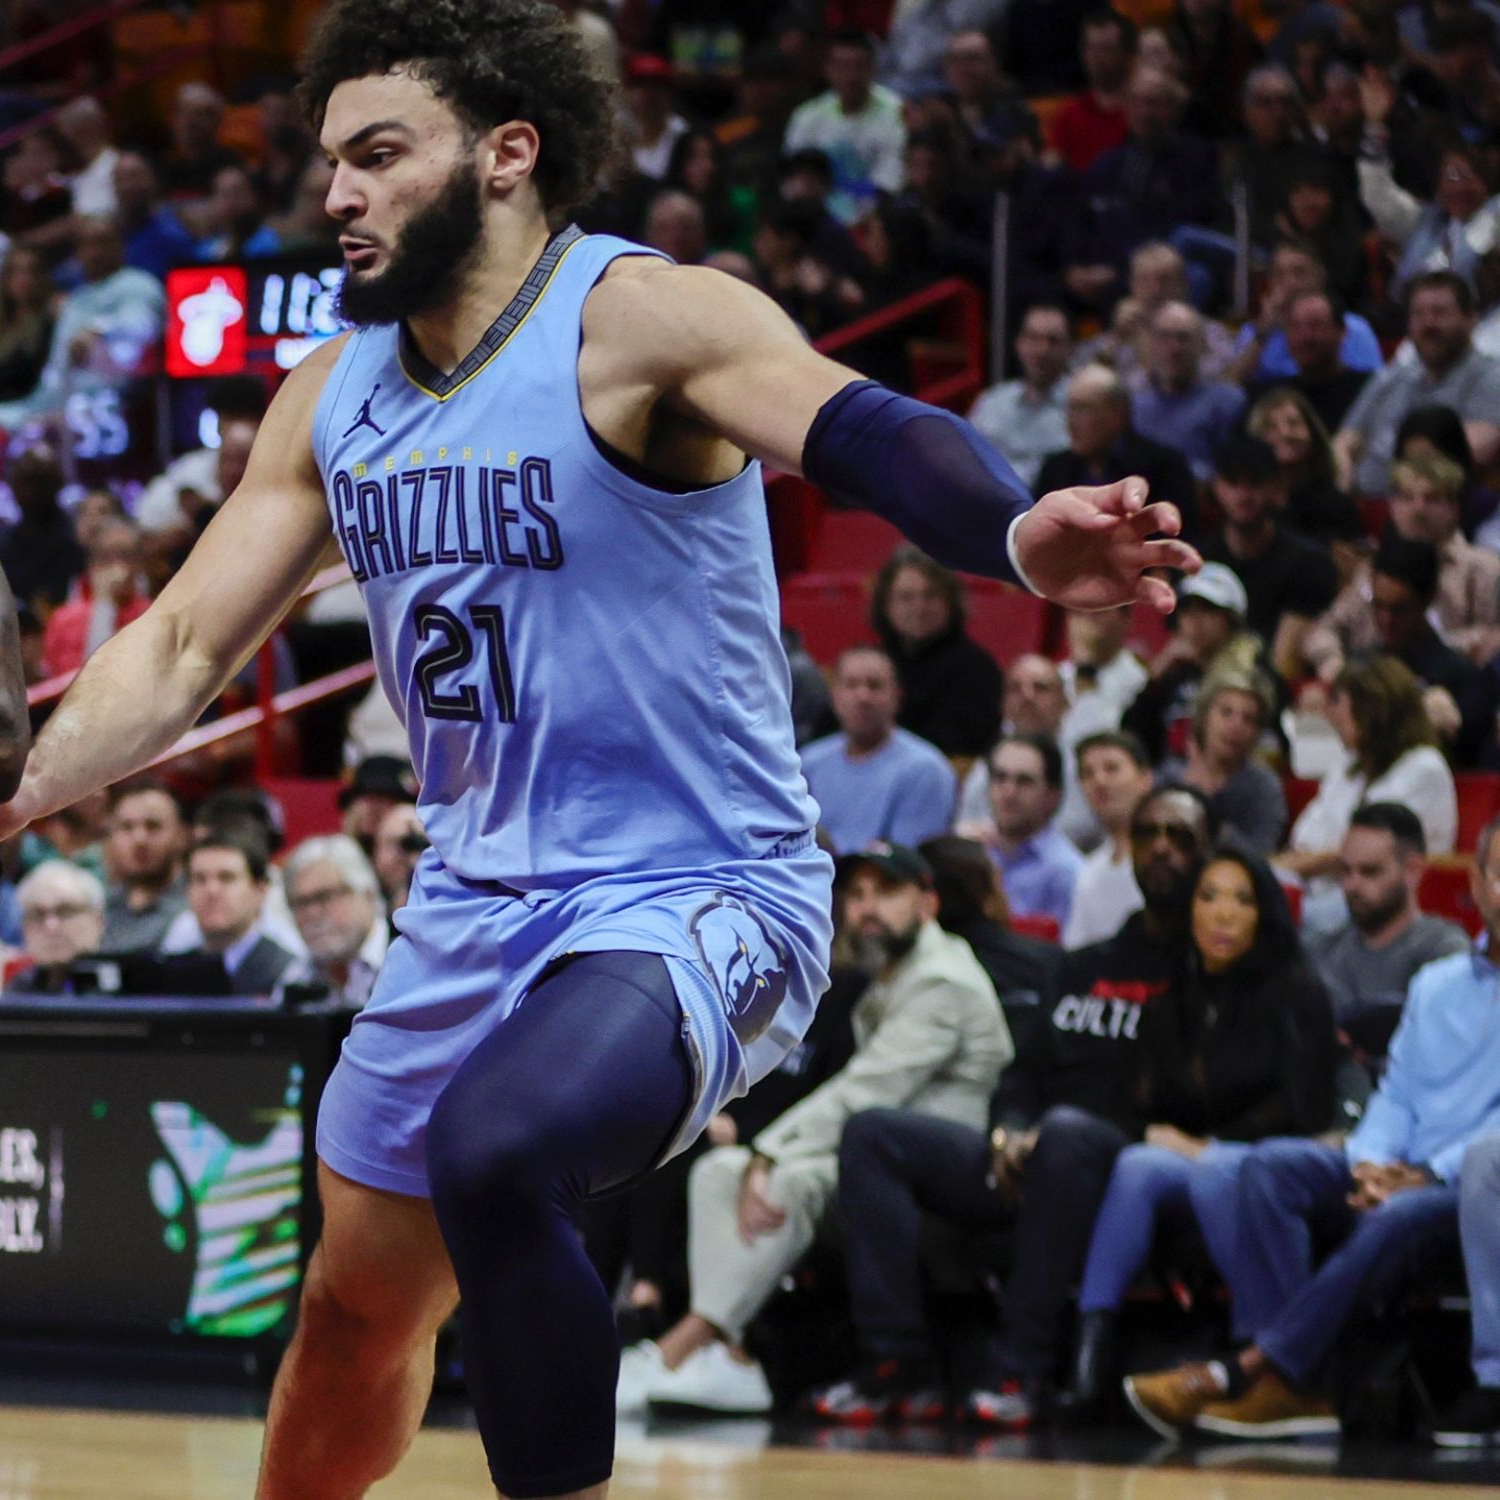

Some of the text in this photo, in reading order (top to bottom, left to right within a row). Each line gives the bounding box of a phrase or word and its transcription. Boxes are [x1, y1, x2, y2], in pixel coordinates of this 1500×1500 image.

[333, 456, 564, 583] GRIZZLIES
[353, 447, 518, 477] MEMPHIS
[413, 603, 516, 724] 21
